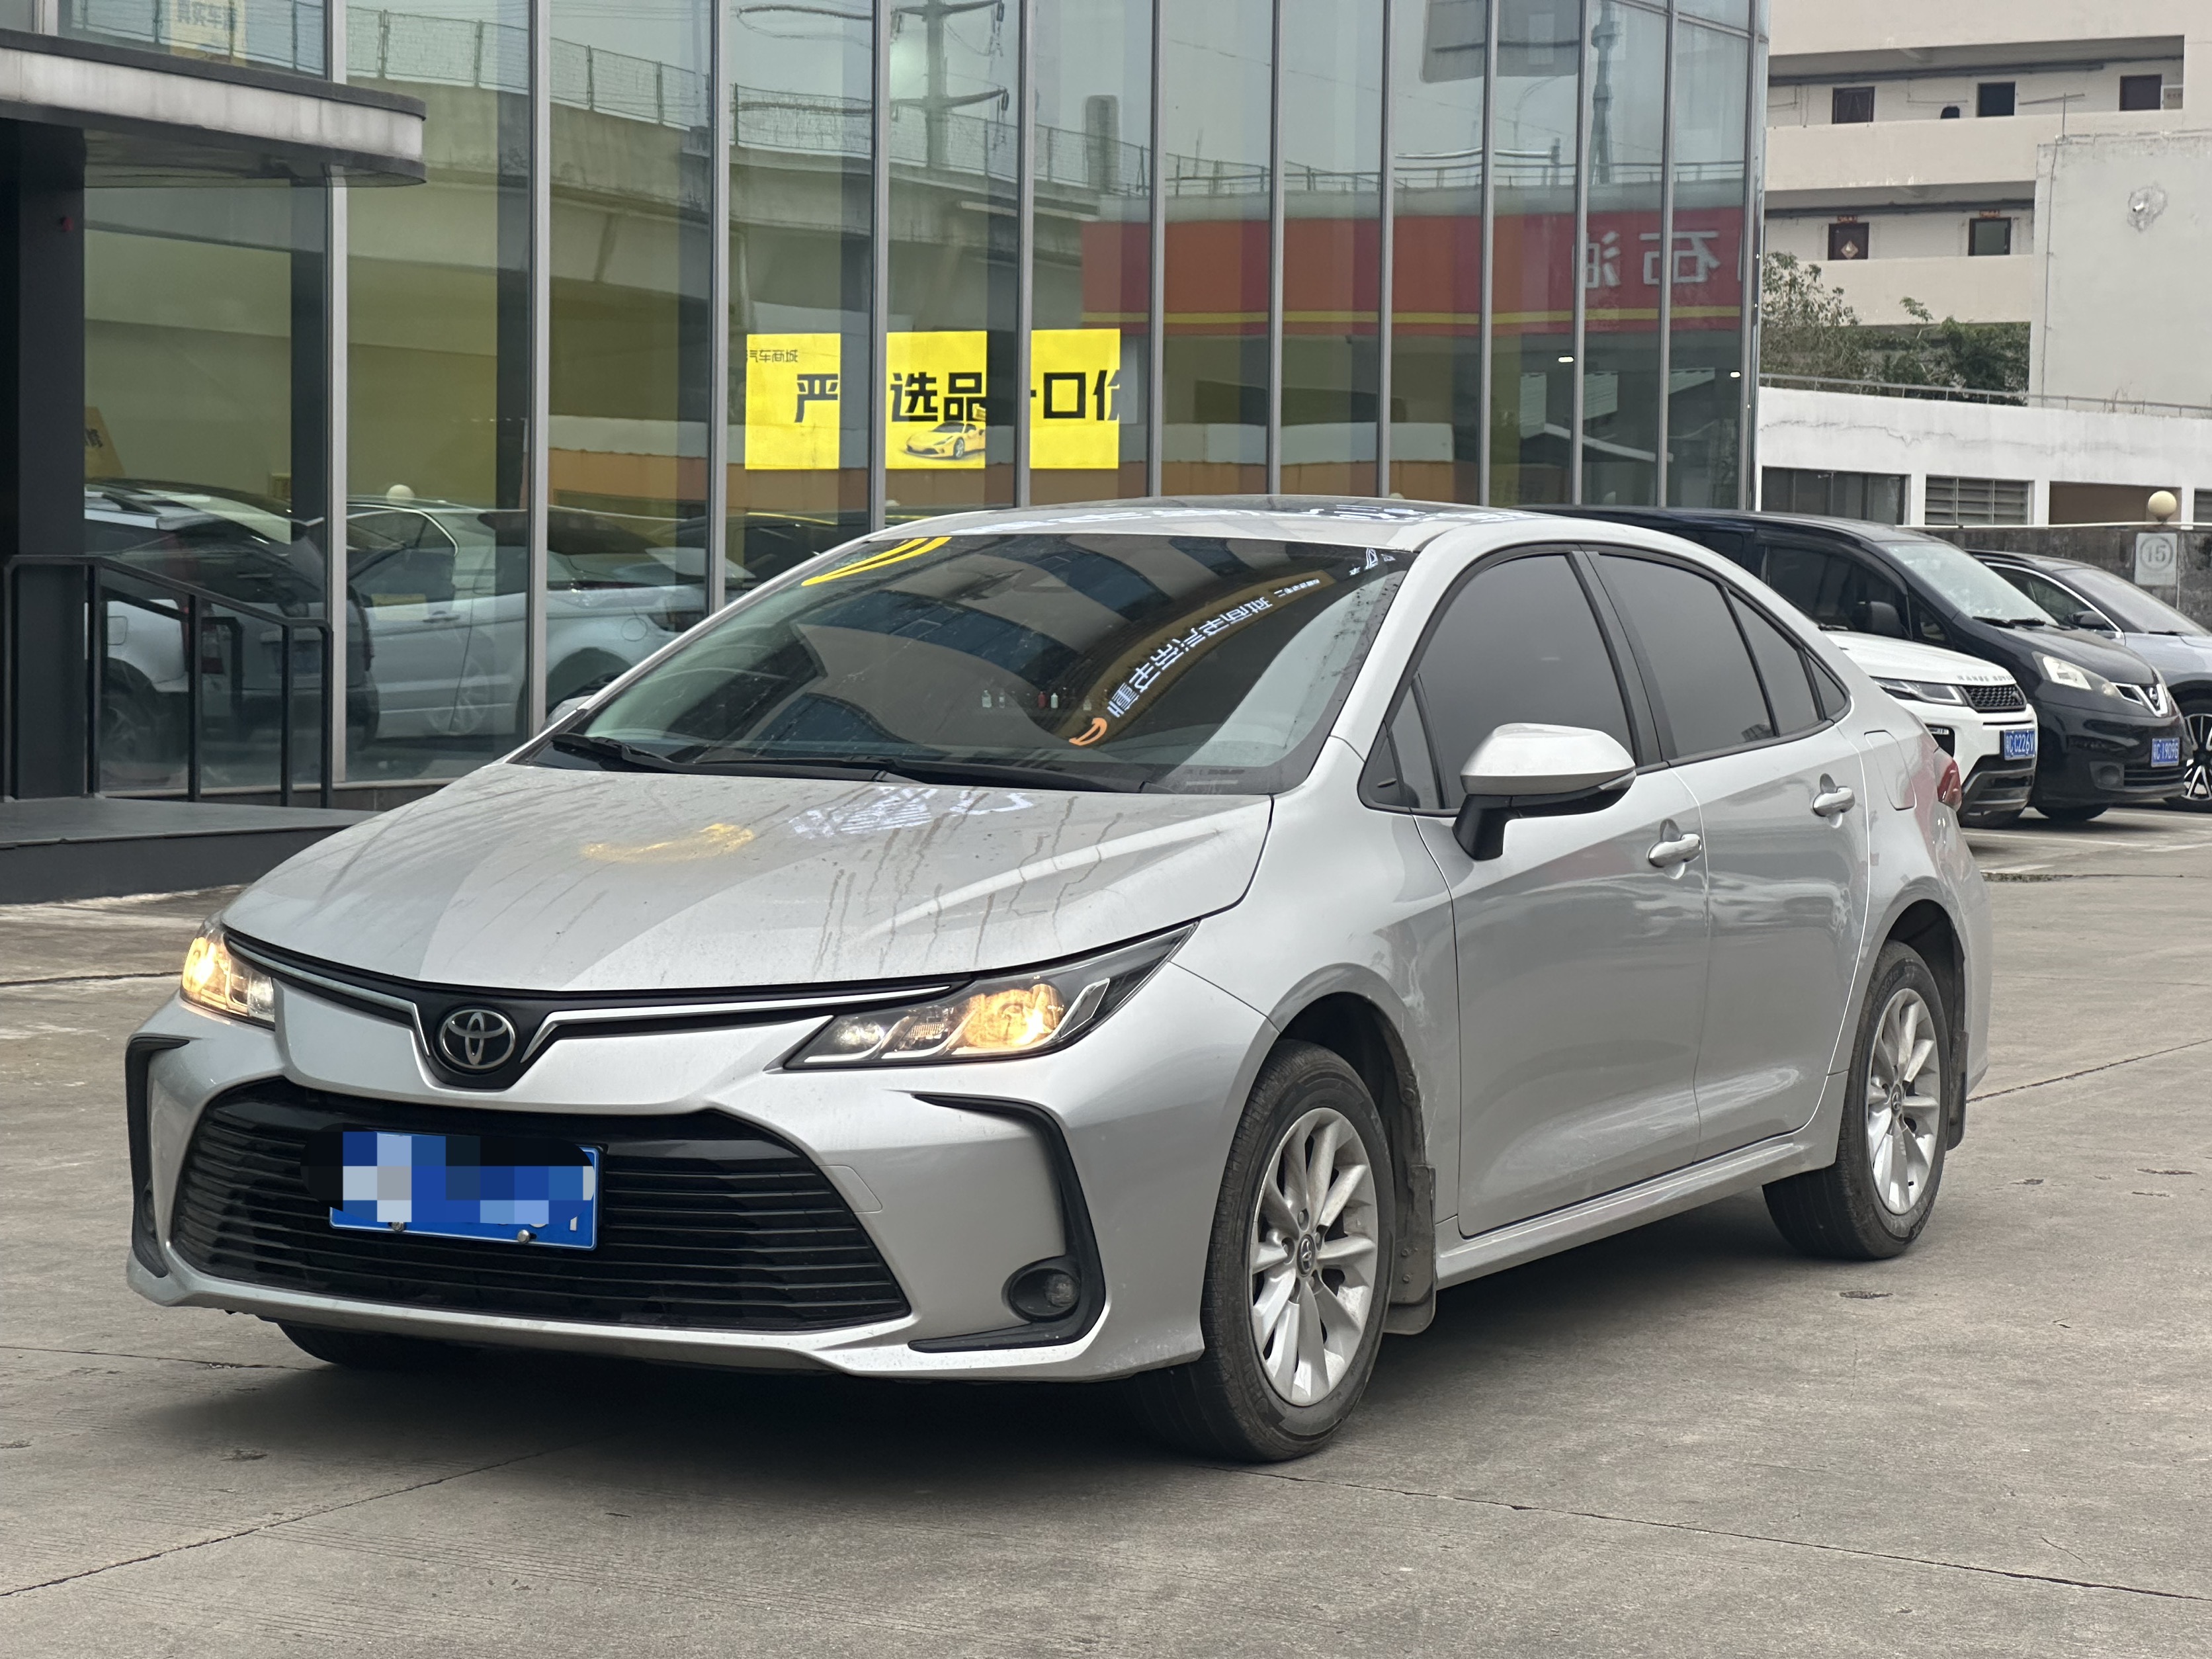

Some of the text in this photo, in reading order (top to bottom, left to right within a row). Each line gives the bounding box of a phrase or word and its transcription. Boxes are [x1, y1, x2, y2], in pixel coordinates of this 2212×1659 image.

[794, 373, 839, 423] 严
[890, 371, 986, 423] 选品
[2145, 544, 2167, 562] 15
